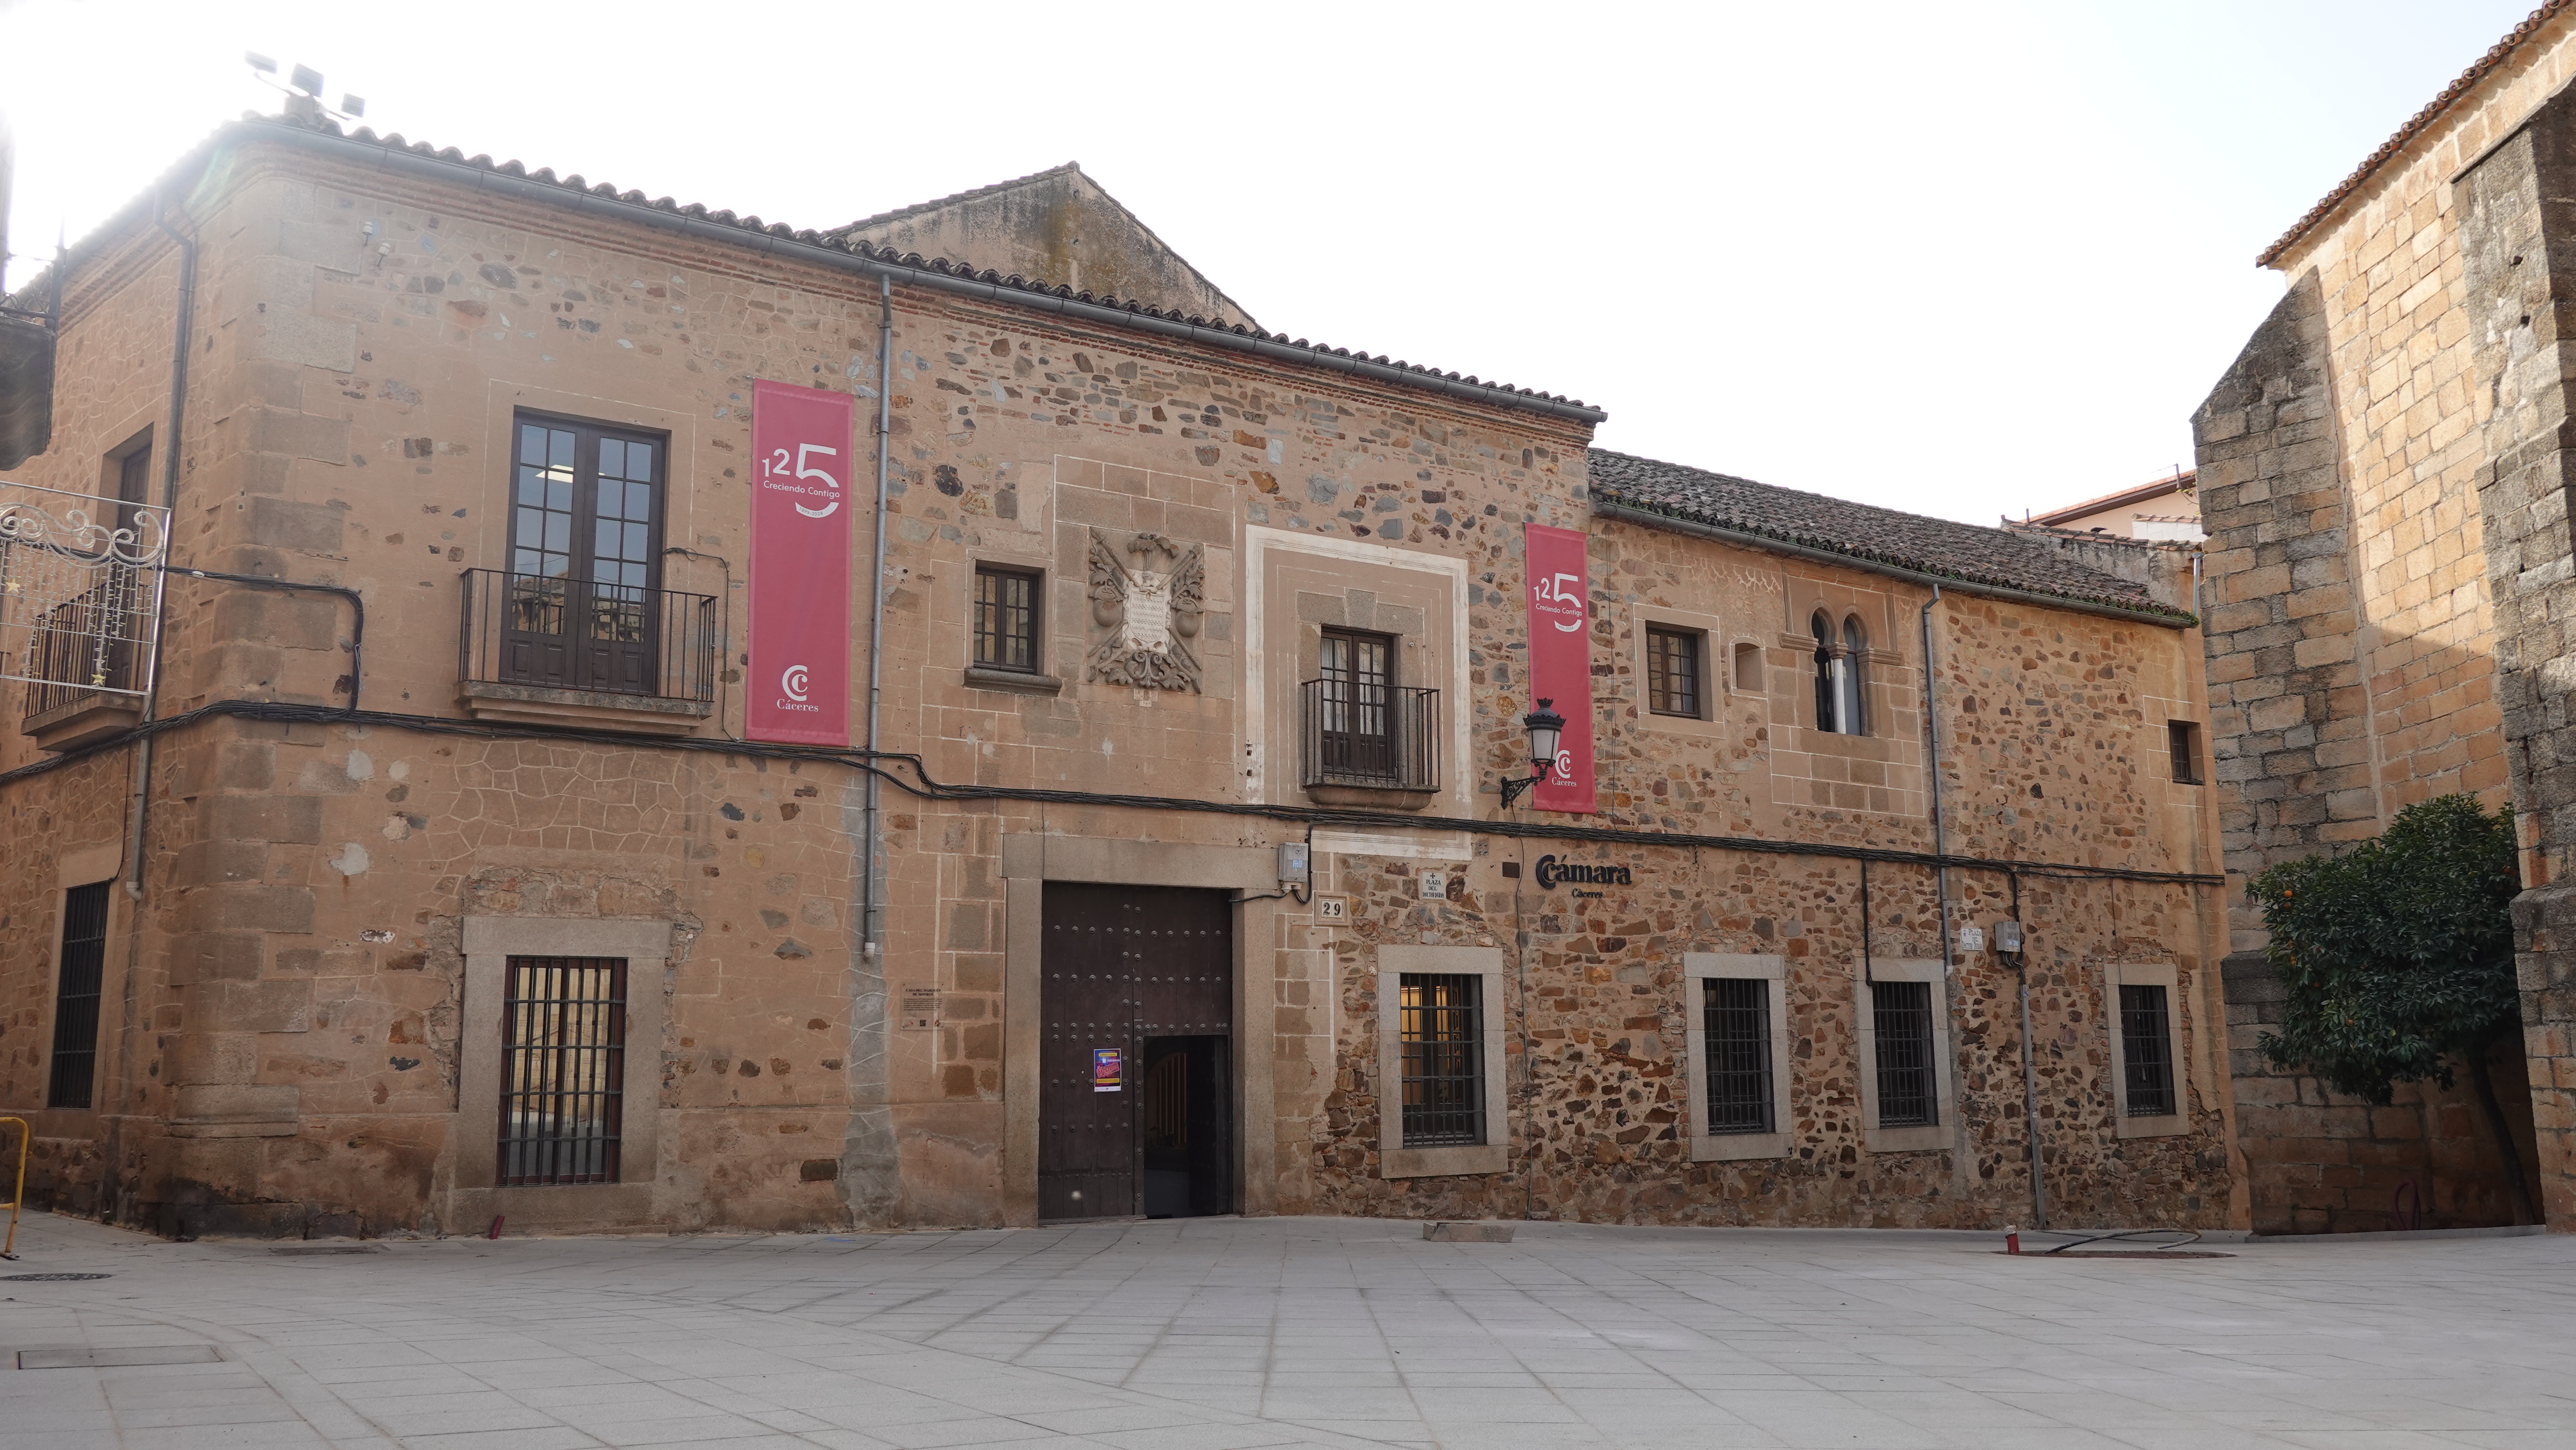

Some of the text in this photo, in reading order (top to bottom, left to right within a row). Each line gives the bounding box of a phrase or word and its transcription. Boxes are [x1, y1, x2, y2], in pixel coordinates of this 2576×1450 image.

[762, 443, 839, 518] 125
[764, 480, 840, 499] Creciendo Contigo
[1533, 572, 1582, 632] 125
[1536, 603, 1582, 617] Creciendo Contigo
[777, 698, 819, 712] Cáceres
[1552, 776, 1577, 787] Cáceres
[1571, 888, 1603, 898] Cáceres
[1323, 902, 1341, 916] 29
